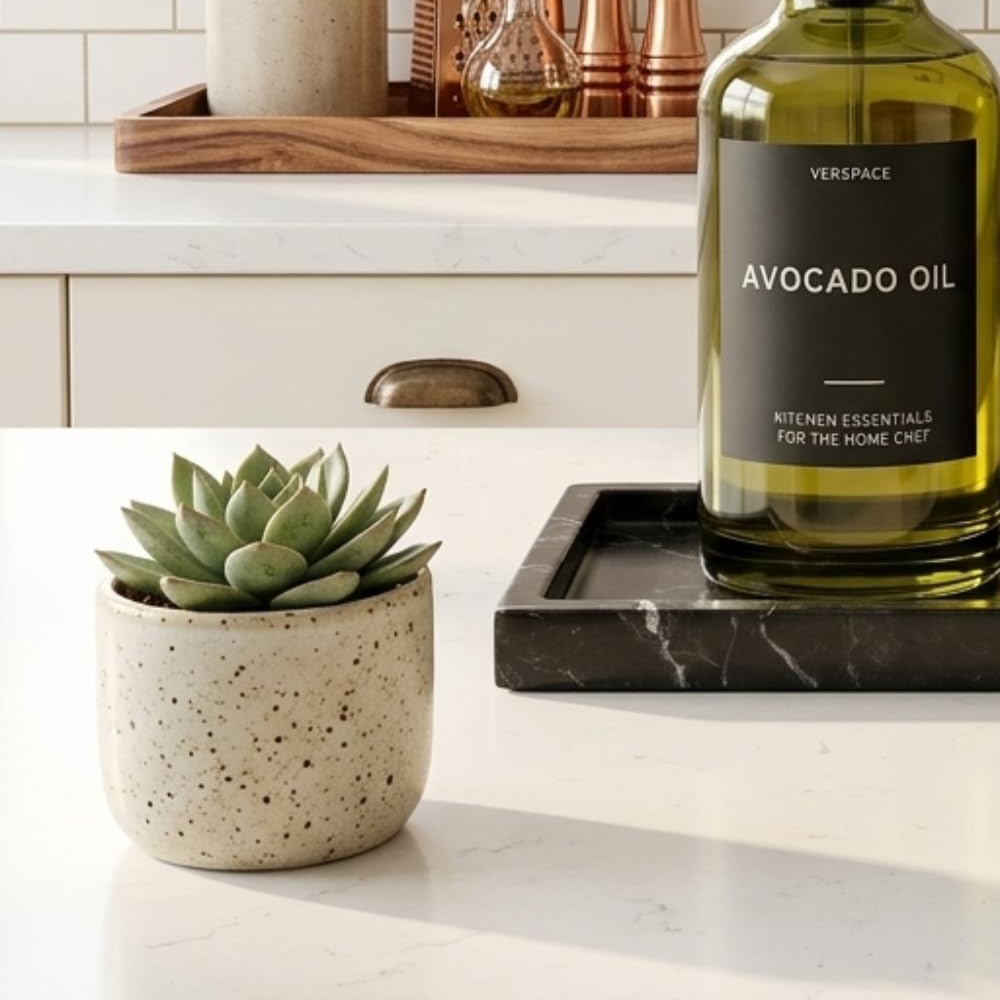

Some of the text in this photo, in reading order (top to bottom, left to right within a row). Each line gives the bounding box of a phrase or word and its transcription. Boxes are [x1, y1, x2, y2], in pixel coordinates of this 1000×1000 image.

[810, 166, 891, 181] VERSPACE
[741, 263, 956, 294] AVOCADO OIL
[841, 409, 933, 428] ESSENTIALS
[777, 428, 931, 447] FOR THE HOME CHEF
